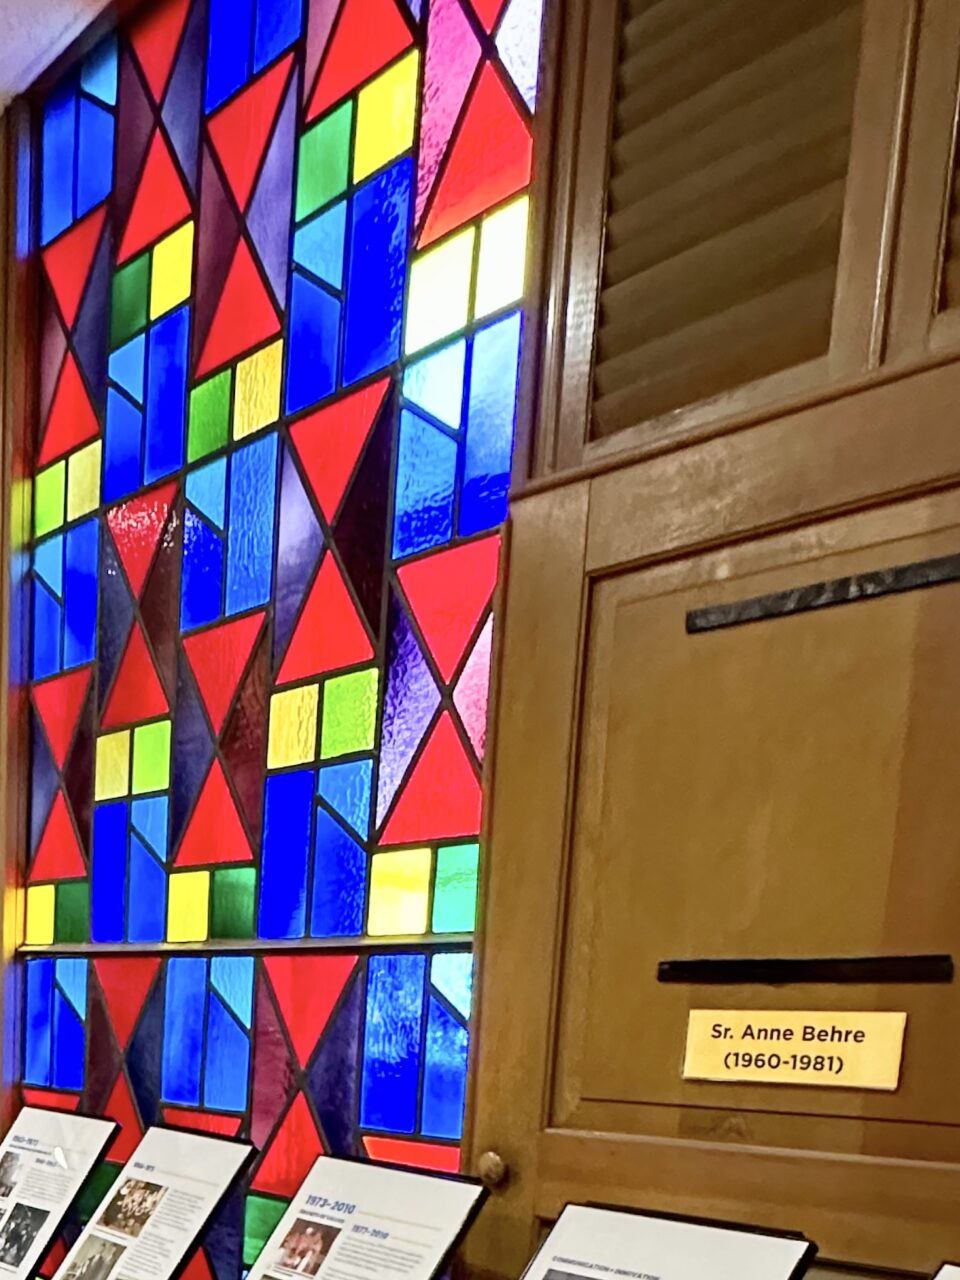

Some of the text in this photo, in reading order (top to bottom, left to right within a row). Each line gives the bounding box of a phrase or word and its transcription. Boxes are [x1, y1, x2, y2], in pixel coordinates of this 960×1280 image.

[711, 1023, 866, 1043] Sr. Anne Behre
[723, 1052, 844, 1075] (1960-1981)
[305, 1194, 357, 1215] 1973-2010
